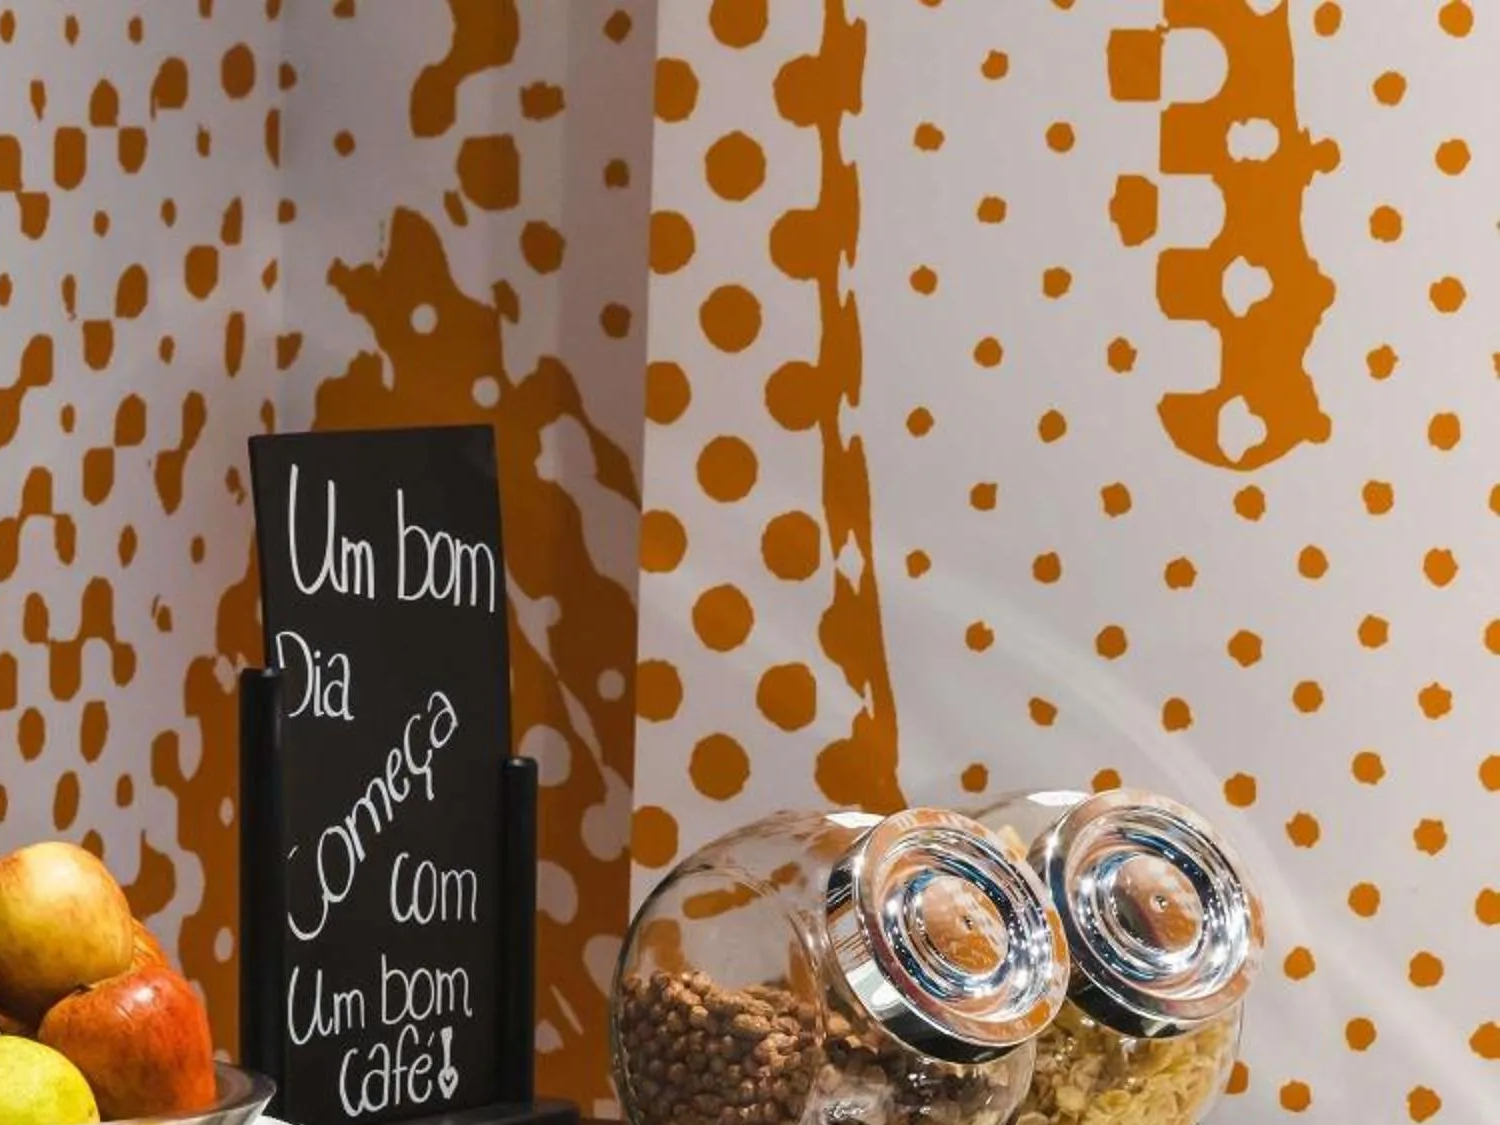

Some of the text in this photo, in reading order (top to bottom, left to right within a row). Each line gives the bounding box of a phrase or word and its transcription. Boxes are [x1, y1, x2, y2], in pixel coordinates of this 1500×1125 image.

[288, 463, 495, 613] Um bom
[275, 631, 355, 721] Dia
[287, 953, 473, 1045] Um bom
